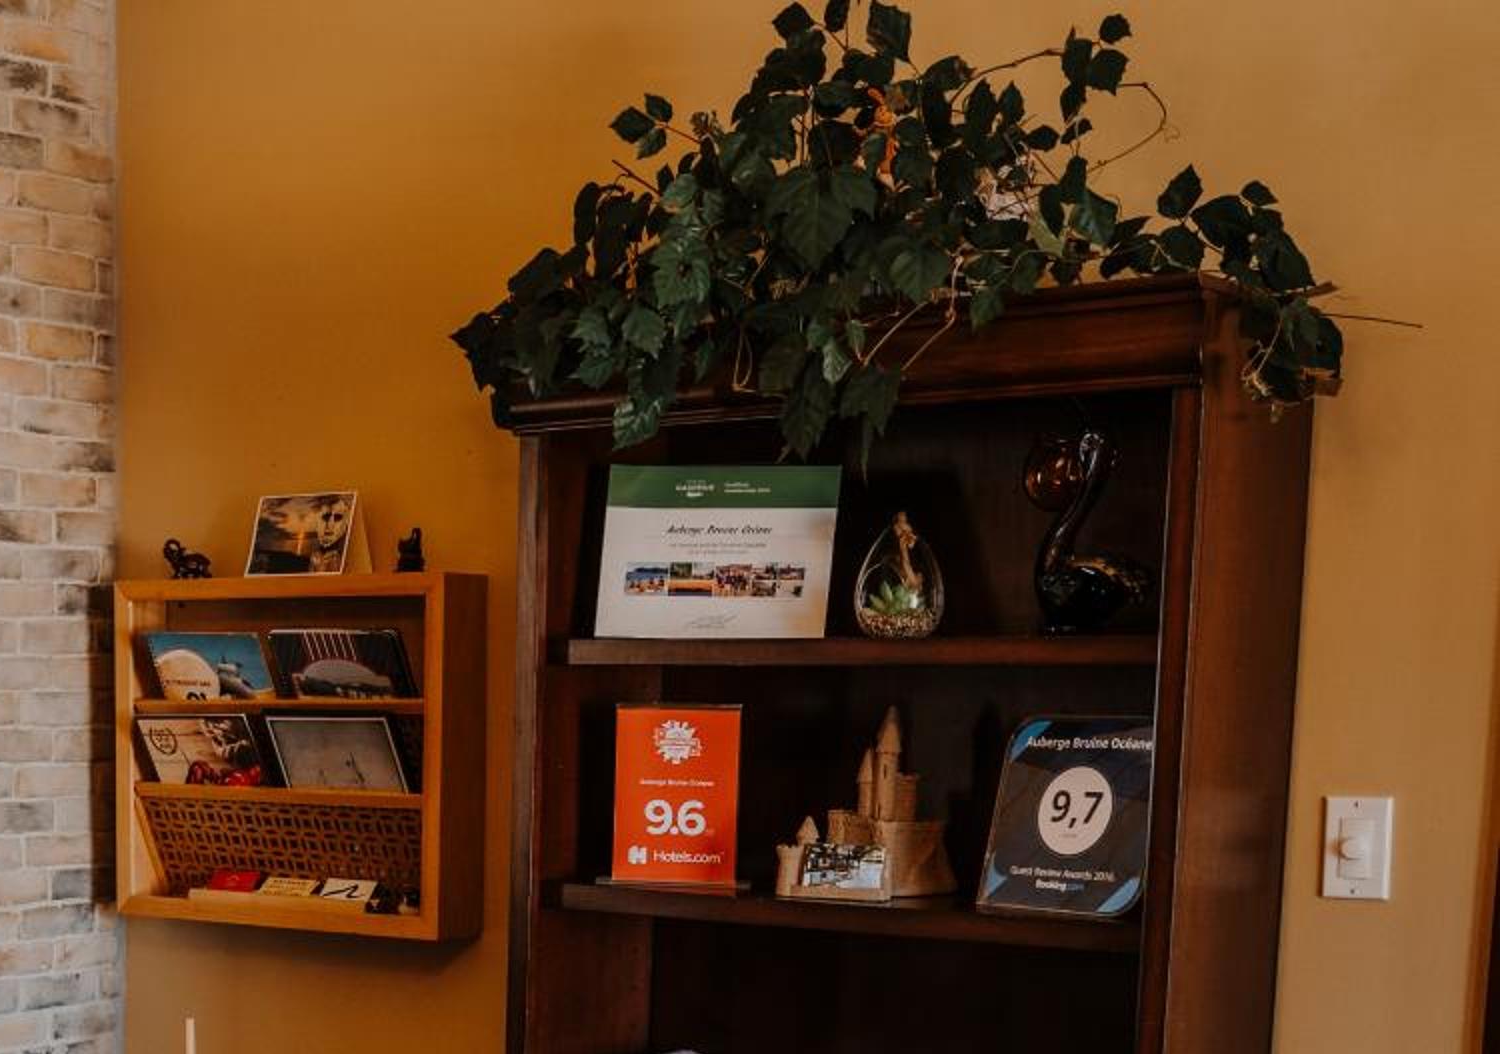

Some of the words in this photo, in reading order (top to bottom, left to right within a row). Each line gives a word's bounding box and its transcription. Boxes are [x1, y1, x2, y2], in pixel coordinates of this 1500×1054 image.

[1026, 736, 1071, 751] Auberge
[1073, 737, 1109, 750] Bruine
[644, 799, 706, 836] 9.6
[1051, 790, 1104, 829] 9,7
[653, 849, 721, 864] Hotels.com
[1009, 865, 1033, 876] Guest
[1034, 867, 1061, 878] Review
[1062, 869, 1092, 881] Awards
